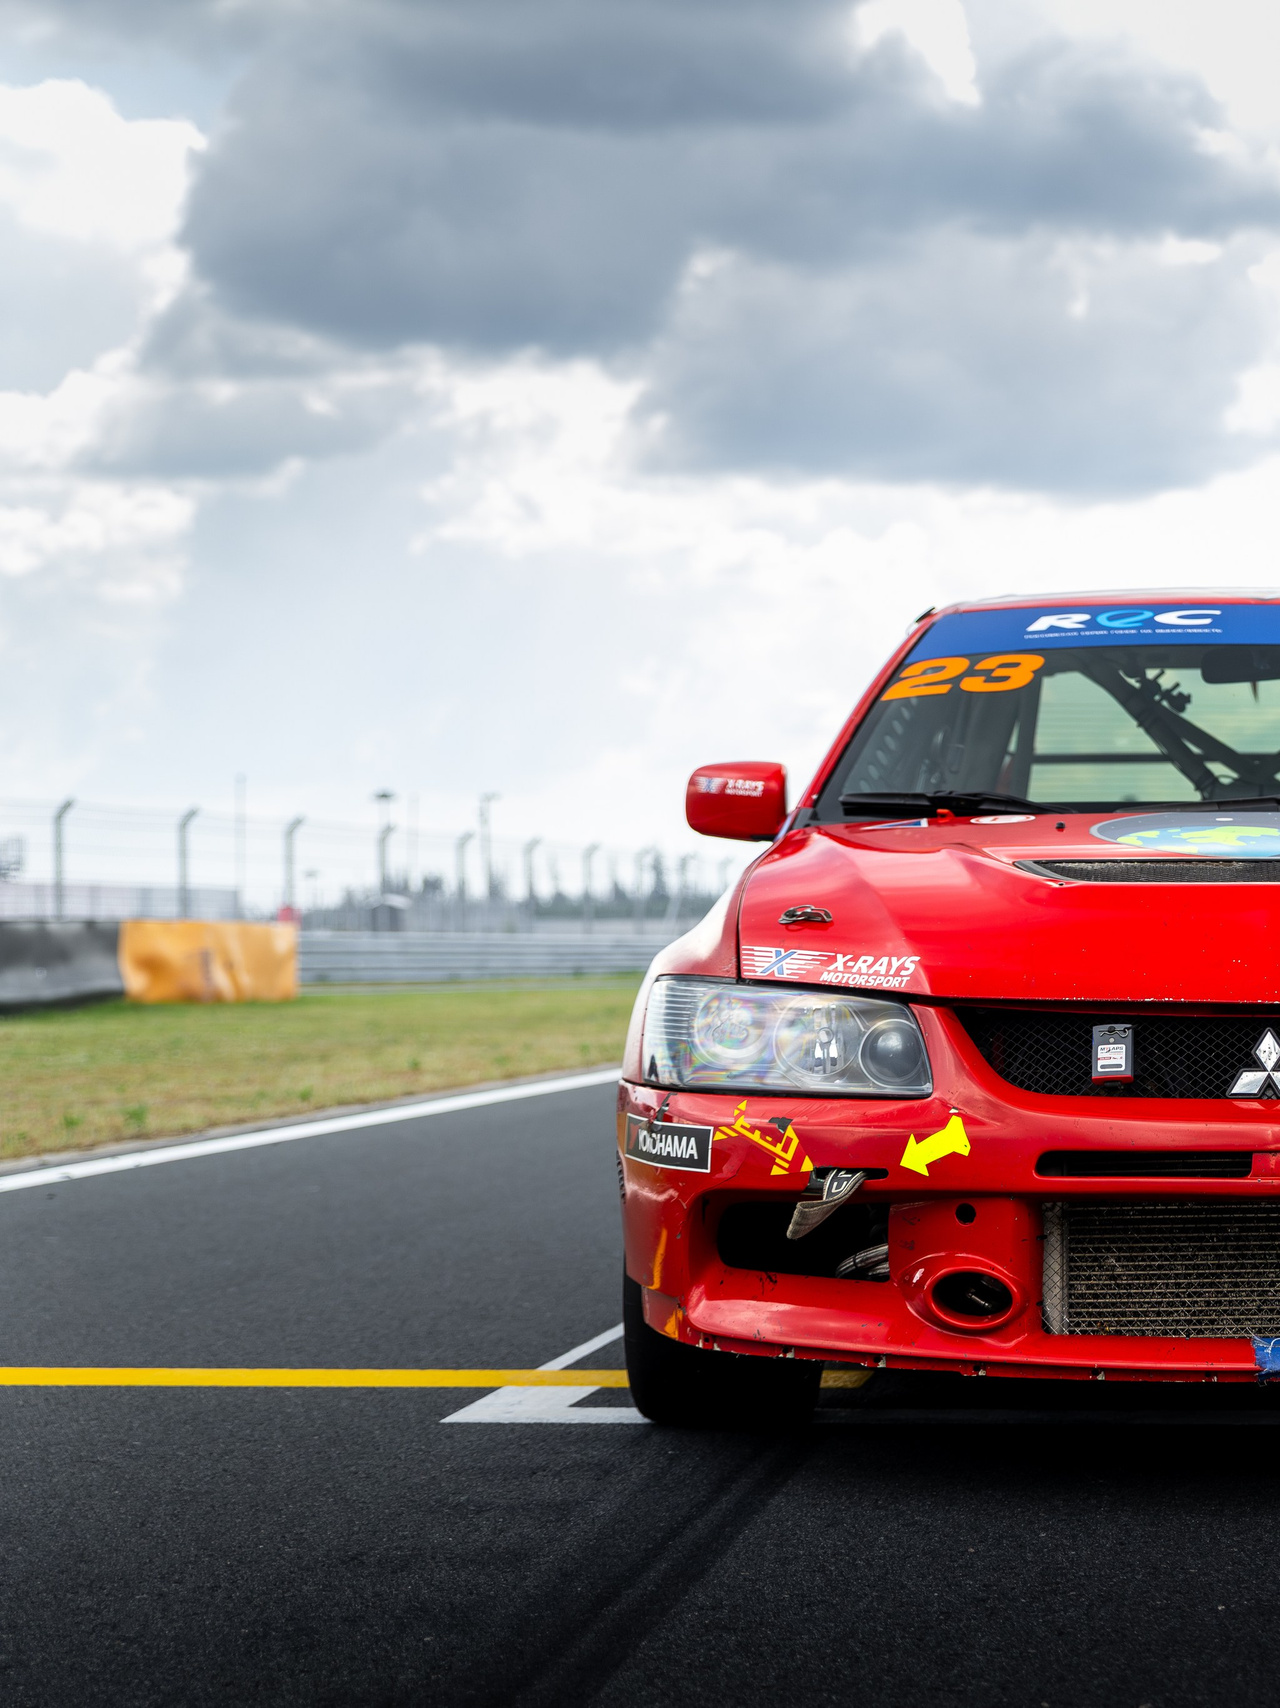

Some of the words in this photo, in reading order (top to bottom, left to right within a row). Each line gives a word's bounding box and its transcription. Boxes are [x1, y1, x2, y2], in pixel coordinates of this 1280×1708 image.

[880, 654, 1045, 701] 23
[827, 953, 921, 976] X-RAYS
[819, 971, 910, 988] MOTORSPORT
